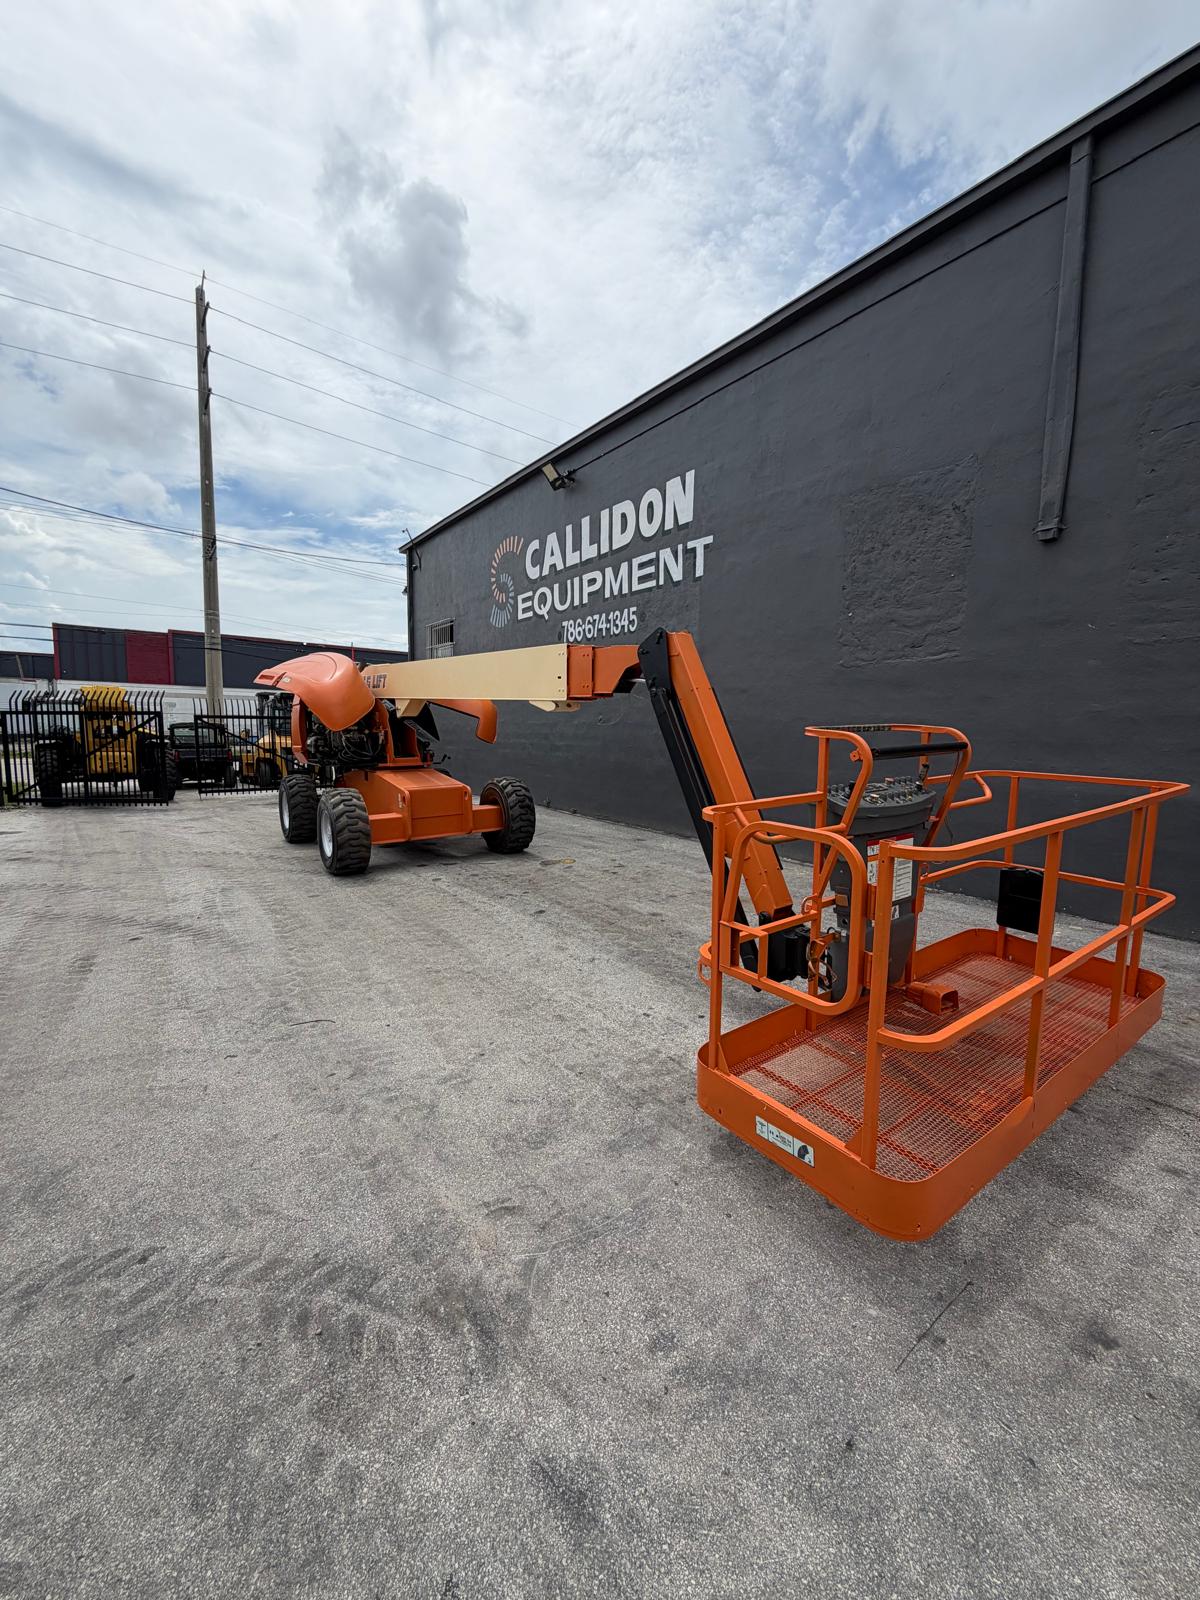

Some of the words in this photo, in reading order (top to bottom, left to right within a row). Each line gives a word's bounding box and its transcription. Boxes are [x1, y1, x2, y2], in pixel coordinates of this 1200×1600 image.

[525, 469, 695, 580] CALLIDON
[517, 535, 714, 620] EQUIPMENT
[372, 674, 387, 688] LIFT
